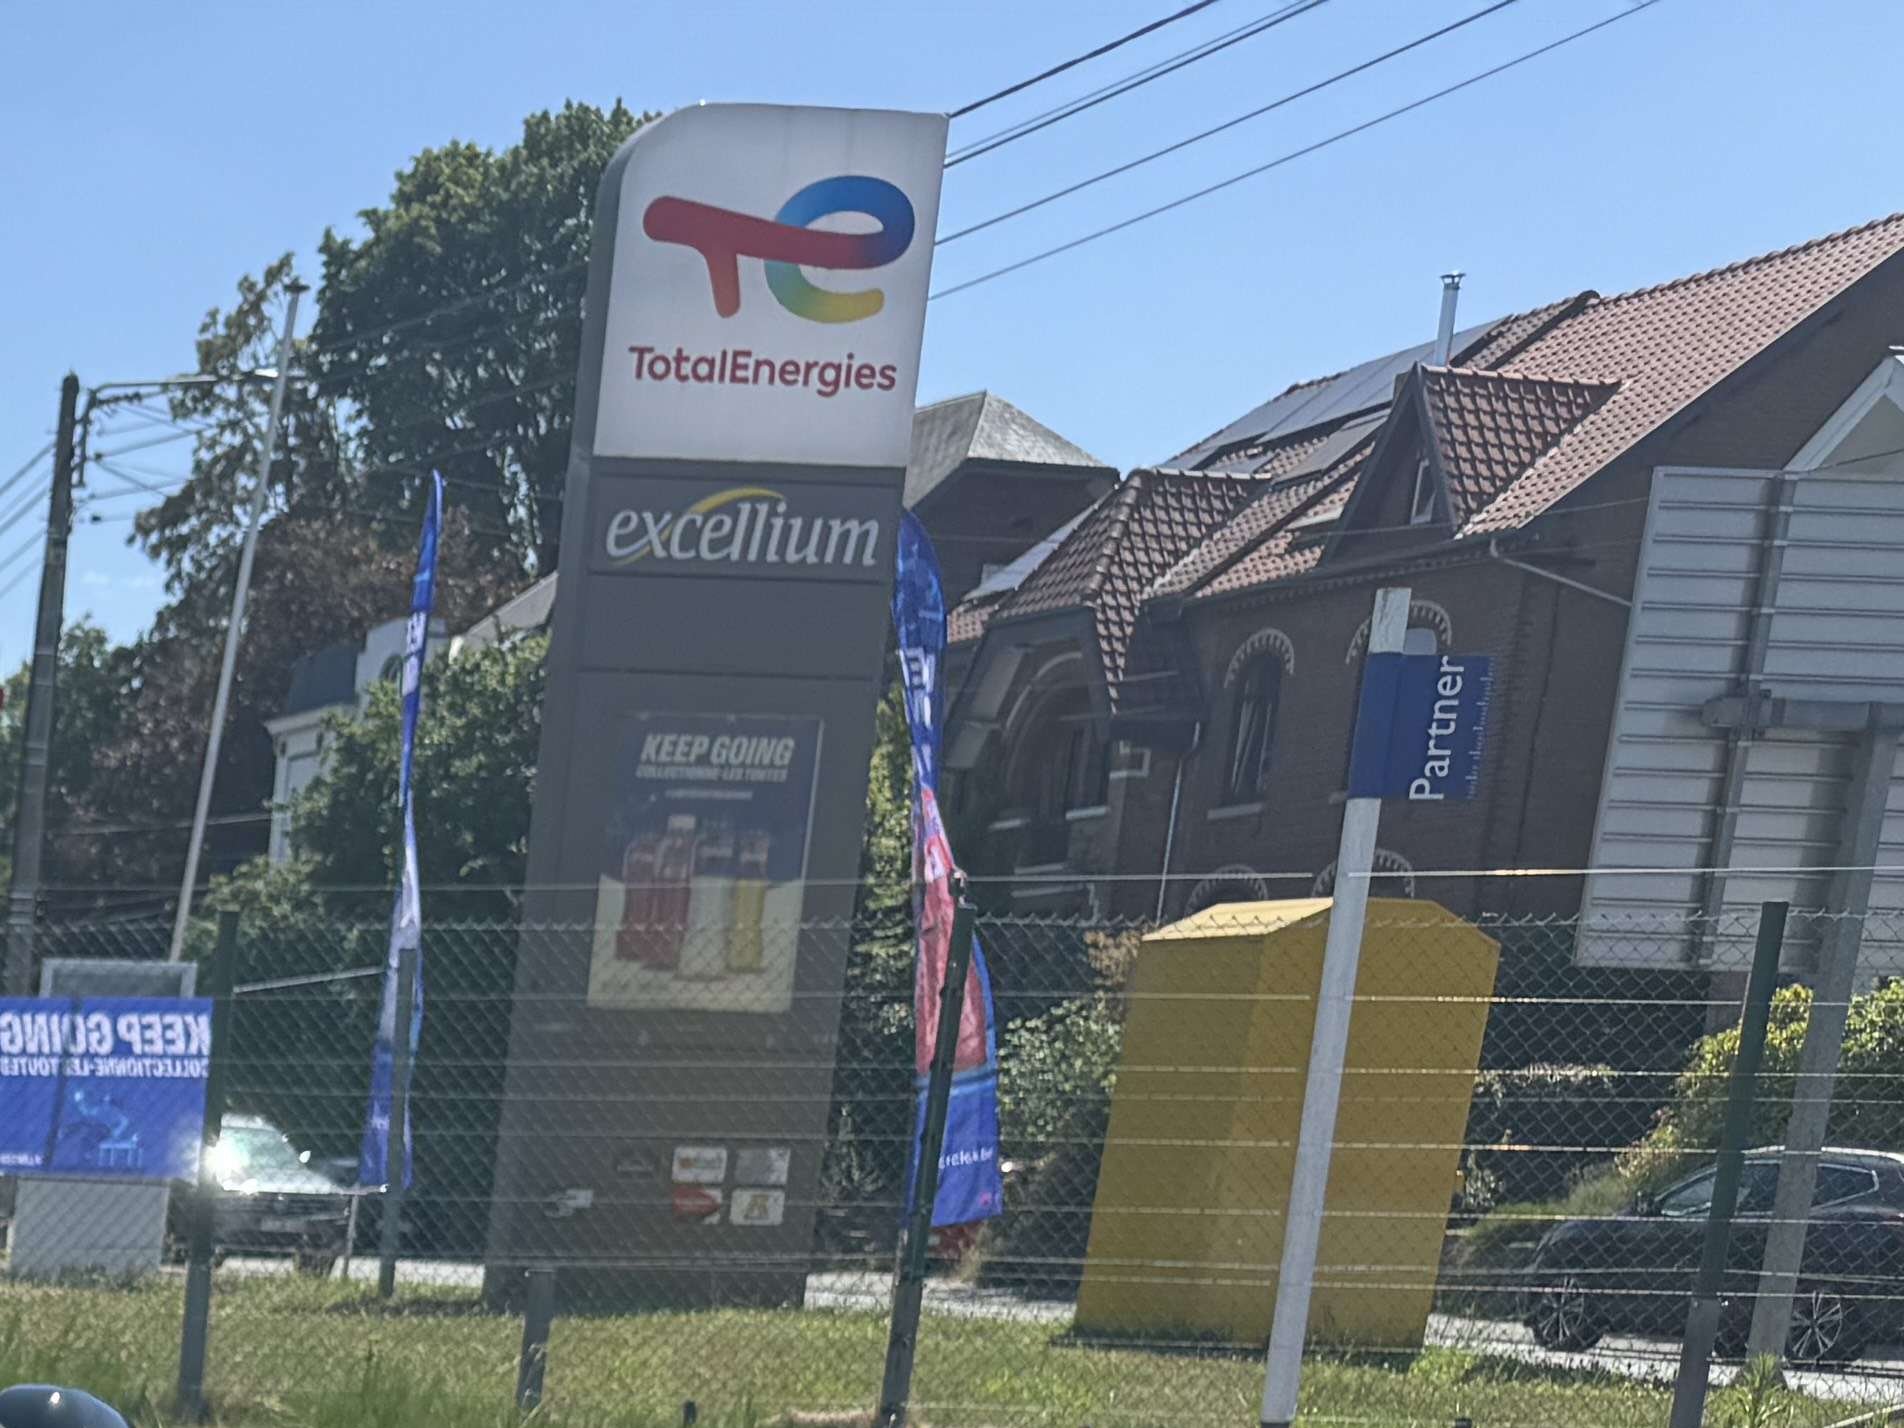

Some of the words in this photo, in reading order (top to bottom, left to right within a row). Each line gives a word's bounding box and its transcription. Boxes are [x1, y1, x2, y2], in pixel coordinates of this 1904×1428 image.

[628, 346, 897, 397] TotalEnergies
[605, 500, 879, 567] excellium
[641, 732, 710, 764] KEEP
[710, 736, 794, 767] GOING
[1408, 655, 1465, 800] Partner
